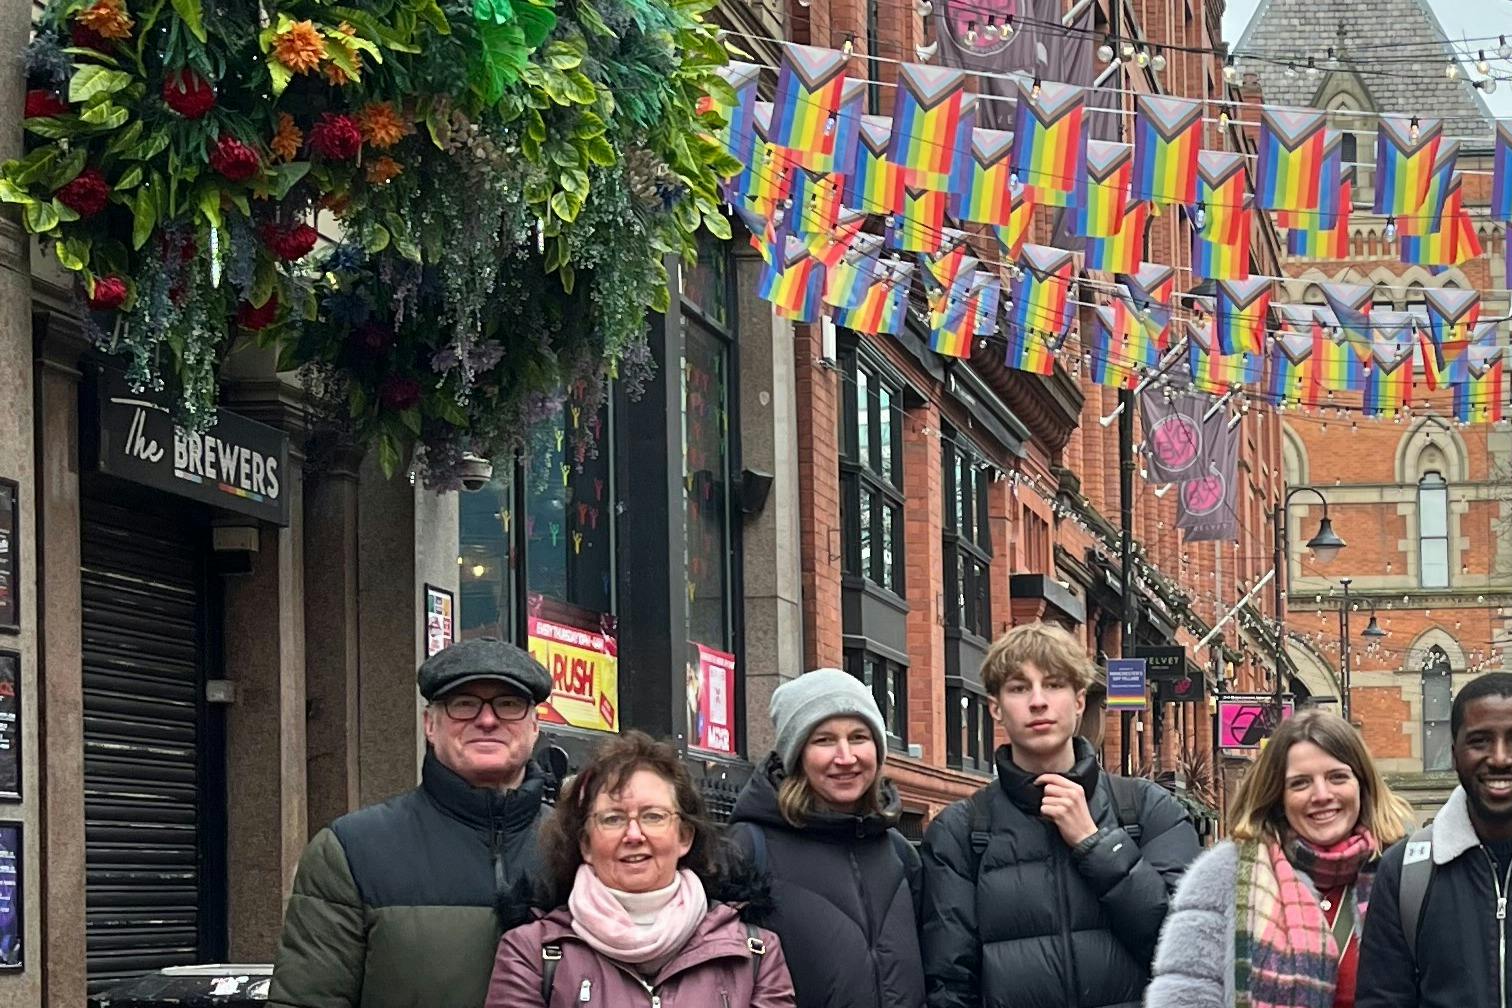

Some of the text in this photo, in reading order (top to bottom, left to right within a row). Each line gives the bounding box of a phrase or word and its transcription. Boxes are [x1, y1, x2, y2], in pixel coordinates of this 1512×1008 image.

[111, 398, 280, 499] The BREWERS
[553, 653, 595, 697] RUSH
[1147, 657, 1180, 665] ELVET
